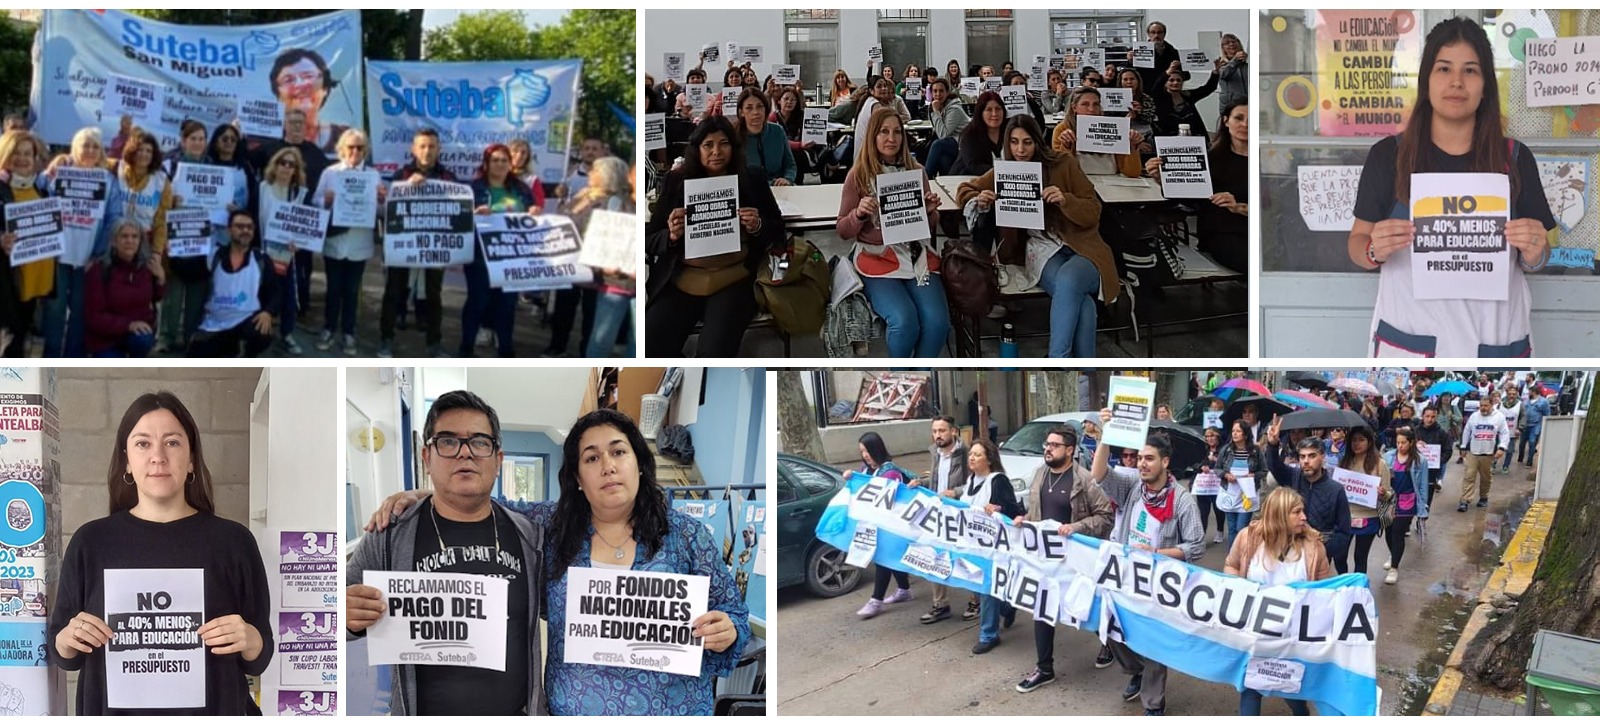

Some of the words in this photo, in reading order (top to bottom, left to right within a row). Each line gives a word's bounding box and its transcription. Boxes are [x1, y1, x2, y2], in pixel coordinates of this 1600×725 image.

[1340, 20, 1347, 33] LA
[122, 19, 239, 65] Suteba
[1333, 39, 1341, 52] NO
[1345, 39, 1368, 52] CAMBIA
[1372, 39, 1379, 52] EL
[1573, 42, 1585, 55] LA
[123, 45, 164, 69] San
[170, 58, 243, 78] Miguel
[1343, 56, 1398, 69] CAMBIA
[1529, 60, 1568, 75] PROMO
[1335, 71, 1340, 89] A
[1343, 71, 1359, 90] LAS
[380, 73, 505, 119] Suteba
[1340, 96, 1403, 109] CAMBIAR
[1355, 112, 1401, 125] MUNDO
[186, 173, 208, 184] PAGO
[210, 175, 225, 185] DEL
[1323, 181, 1335, 191] LA
[193, 184, 217, 195] FONID
[881, 181, 919, 194] DENUNCIAMOS
[689, 189, 734, 202] DENUNCIAMOS
[396, 202, 408, 215] AL
[409, 201, 461, 217] GOBIERNO
[1442, 195, 1477, 214] NO
[275, 211, 320, 228] NACIONALES
[403, 216, 453, 231] NACIONAL
[504, 215, 537, 230] NO
[1422, 225, 1430, 233] AL
[1433, 220, 1457, 233] 40%
[1460, 219, 1496, 234] MENOS
[416, 235, 431, 248] NO
[433, 234, 464, 248] PAGO
[1417, 235, 1443, 248] PARA
[1446, 231, 1502, 248] EDUCACIÓN
[420, 249, 451, 264] FONID
[1461, 253, 1468, 261] el
[504, 263, 577, 281] PRESUPUESTO
[1427, 261, 1493, 272] PRESUPUESTO
[21, 407, 43, 417] PARA
[1347, 477, 1365, 487] PAGO
[302, 532, 334, 555] 3J
[293, 563, 307, 571] HAY
[317, 563, 330, 571] UNA
[857, 483, 895, 510] EN
[1020, 522, 1066, 559] DE
[1132, 560, 1376, 643] ESCUELA
[0, 565, 35, 578] 2023
[388, 579, 472, 594] RECLAMAMOS
[474, 582, 487, 596] EL
[589, 580, 611, 594] POR
[616, 576, 688, 599] FONDOS
[137, 591, 172, 610] NO
[388, 597, 444, 617] PAGO
[452, 598, 487, 619] DEL
[580, 596, 691, 621] NACIONALES
[128, 616, 152, 630] 40%
[155, 616, 192, 630] MENOS
[300, 612, 331, 634] 3J
[410, 621, 468, 640] FONID
[112, 631, 139, 645] PARA
[142, 627, 198, 644] EDUCACIÓN
[569, 623, 598, 637] PARA
[600, 620, 701, 646] EDUCACIÓN
[291, 643, 305, 651] HAY
[148, 652, 156, 660] en
[158, 651, 164, 659] el
[437, 651, 467, 663] Suteba
[630, 653, 660, 667] Suteba
[123, 660, 190, 673] PRESUPUESTO
[1257, 668, 1292, 680] EDUCACIÓN
[300, 691, 330, 712] 3J
